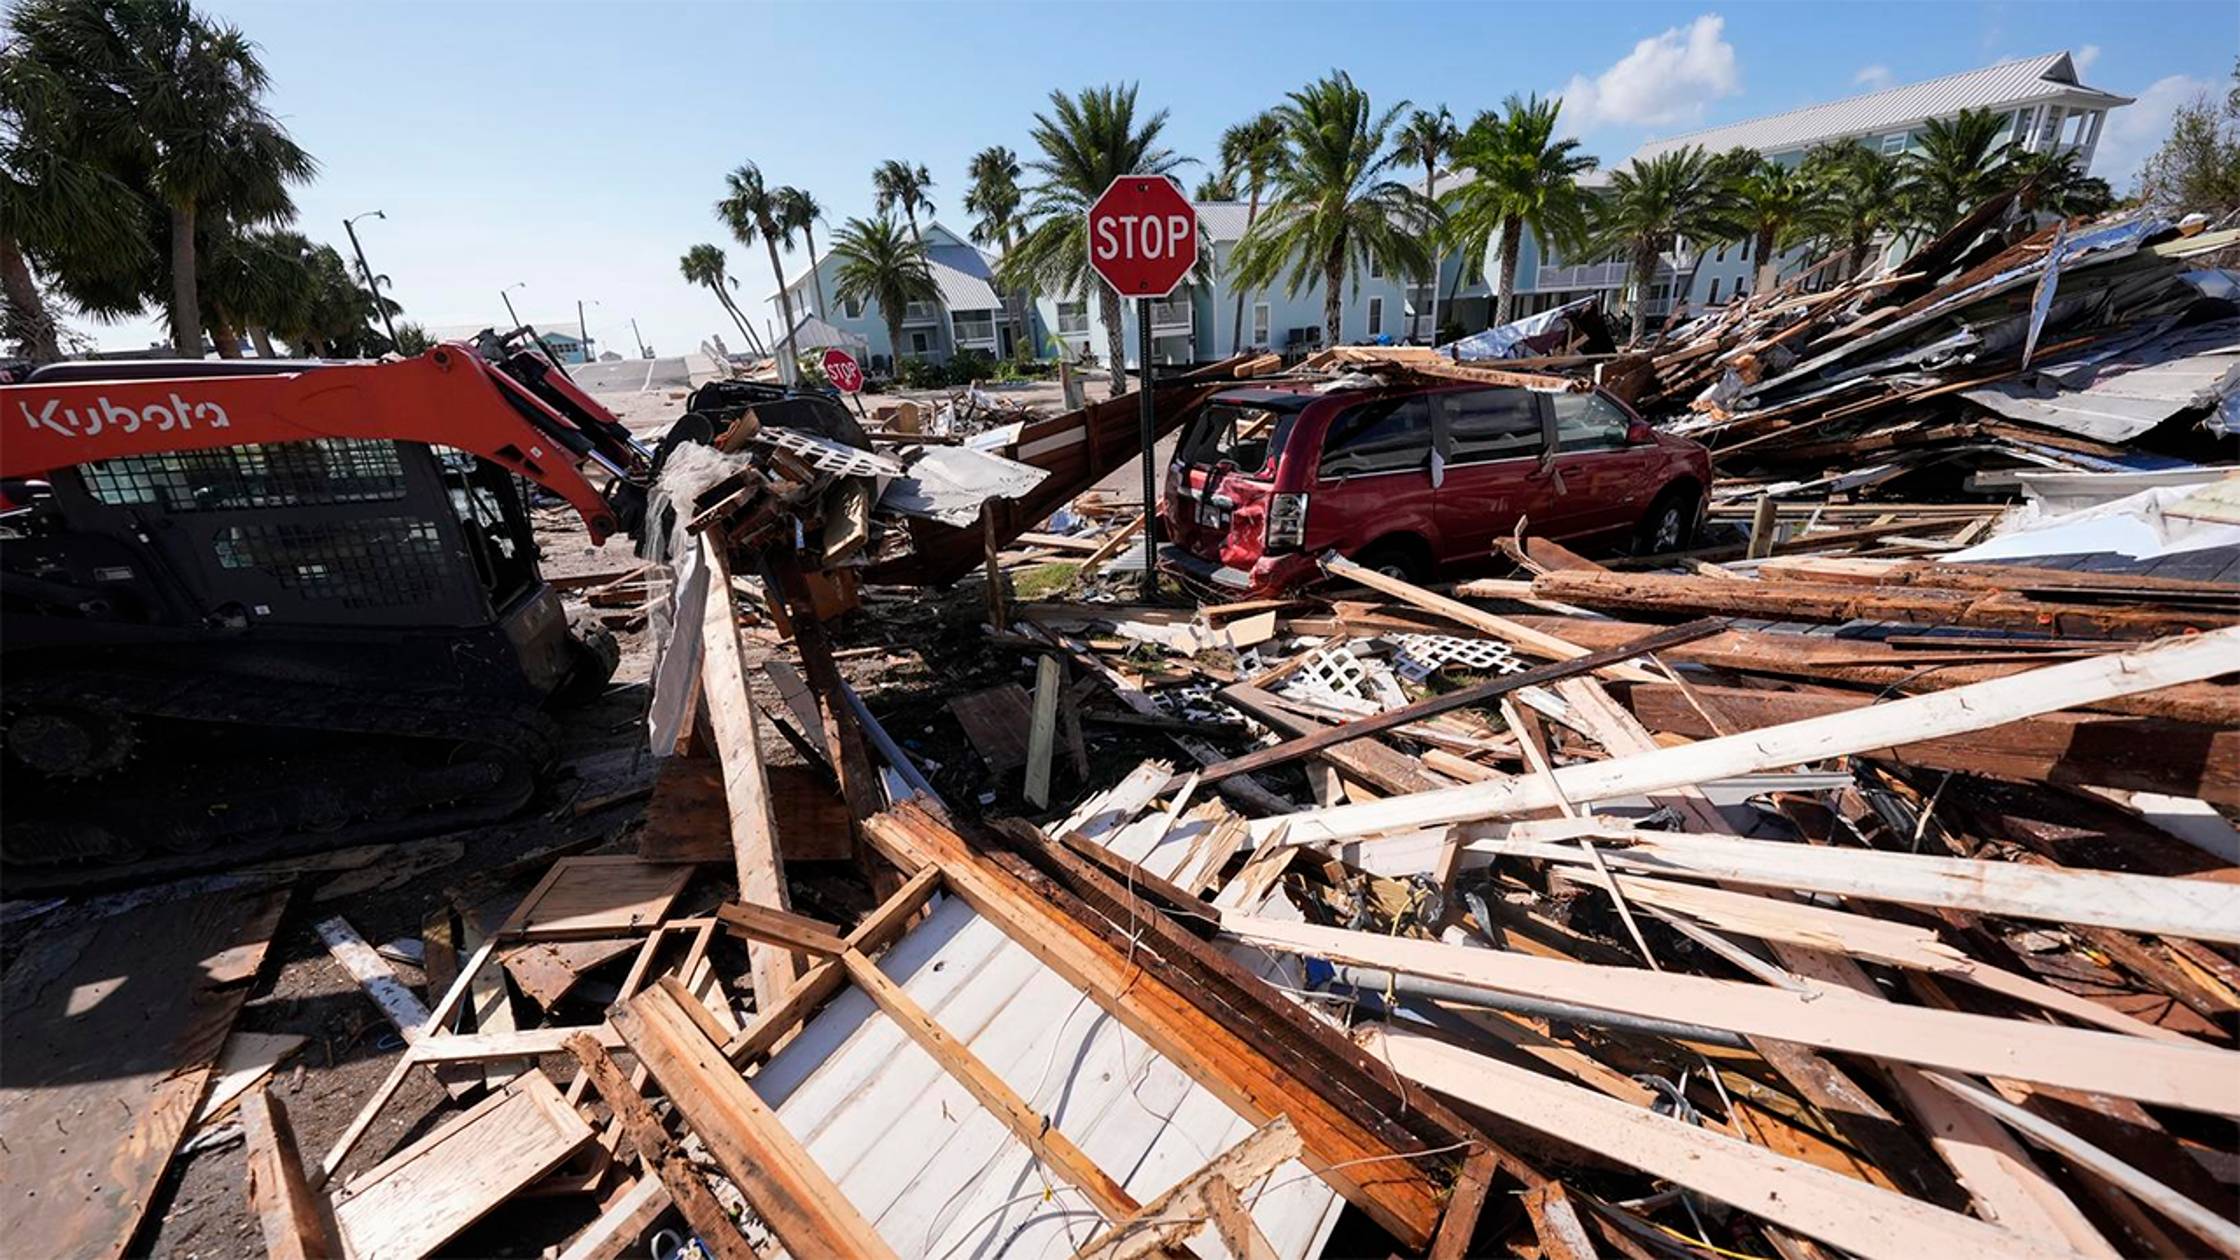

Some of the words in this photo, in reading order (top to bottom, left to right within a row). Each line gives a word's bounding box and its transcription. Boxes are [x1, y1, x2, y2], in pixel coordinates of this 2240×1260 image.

[1096, 215, 1189, 260] STOP
[827, 362, 857, 381] STOP
[19, 393, 230, 437] Kubota
